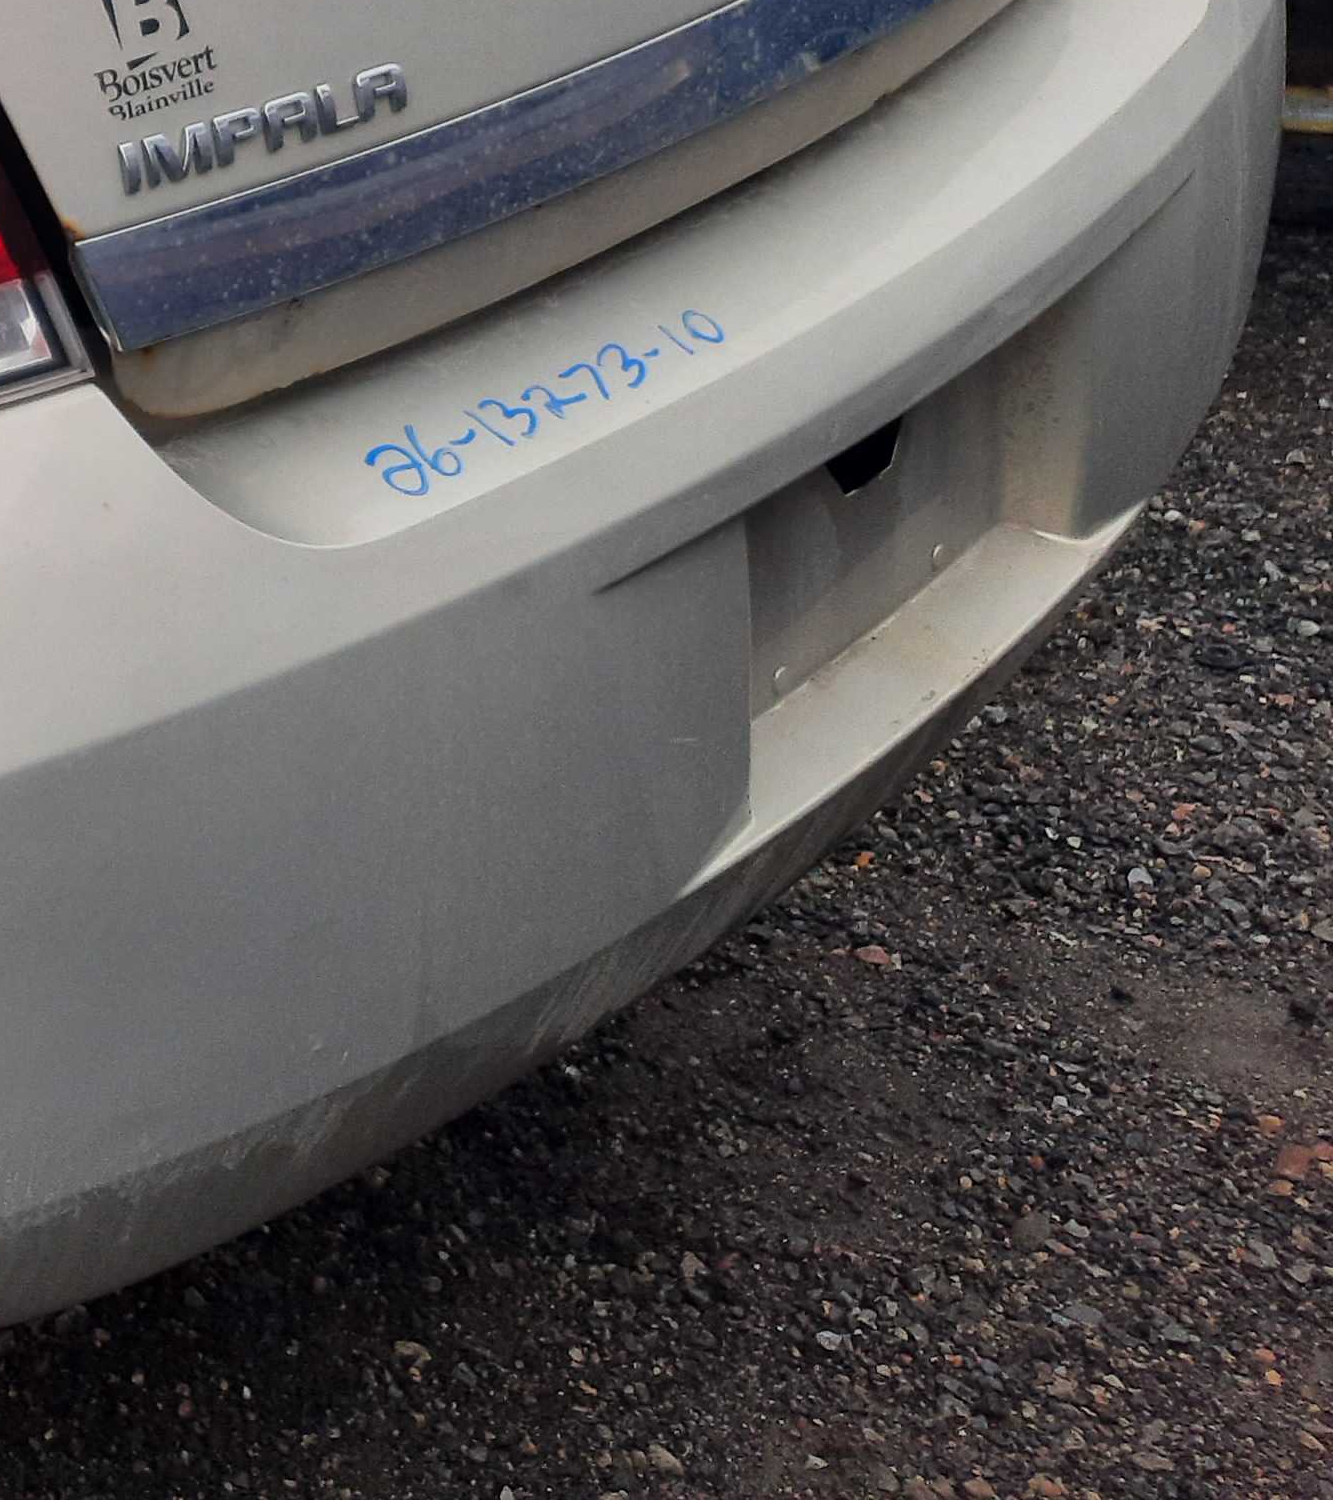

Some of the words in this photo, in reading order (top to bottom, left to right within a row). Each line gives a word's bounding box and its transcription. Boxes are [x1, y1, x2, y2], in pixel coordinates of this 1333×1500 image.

[93, 45, 218, 103] Boisvert
[106, 78, 215, 121] Blainville
[116, 61, 409, 197] IMPALA
[363, 308, 726, 497] 26-13273-10
